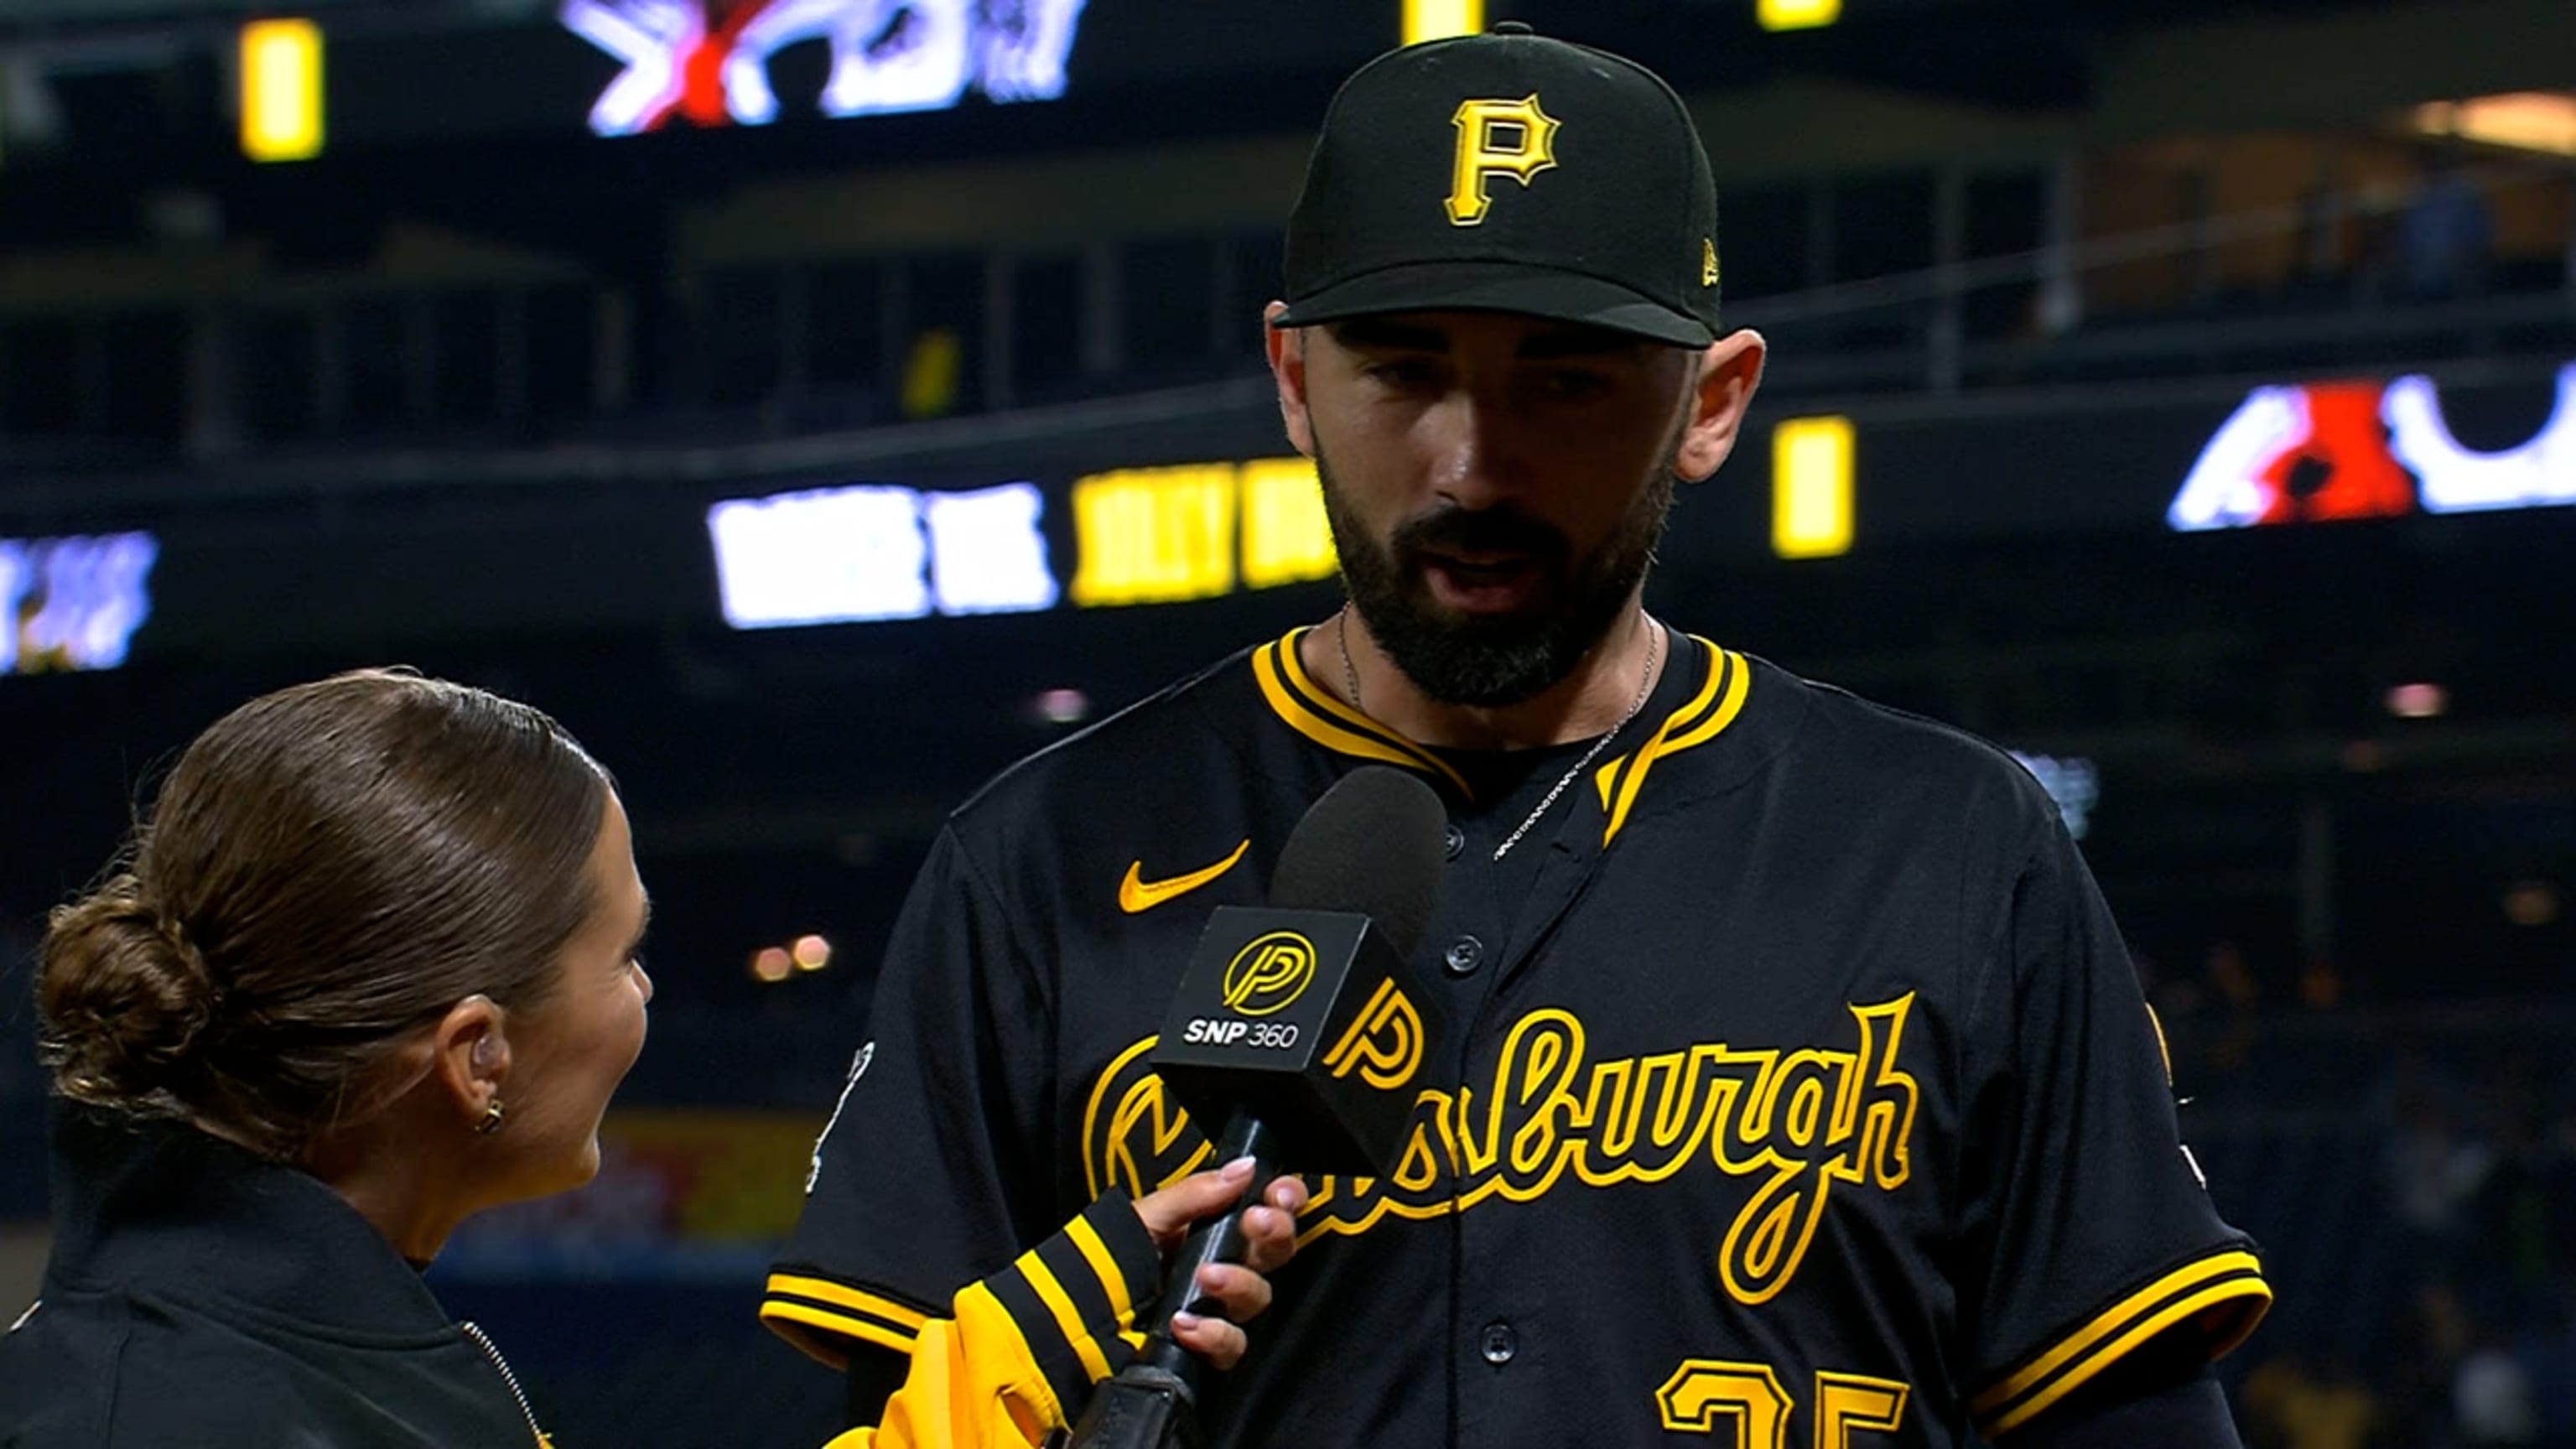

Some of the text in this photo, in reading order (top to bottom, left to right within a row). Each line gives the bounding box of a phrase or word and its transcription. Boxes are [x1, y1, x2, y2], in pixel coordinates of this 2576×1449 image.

[1444, 93, 1561, 226] P
[1183, 1020, 1300, 1048] SNP 360
